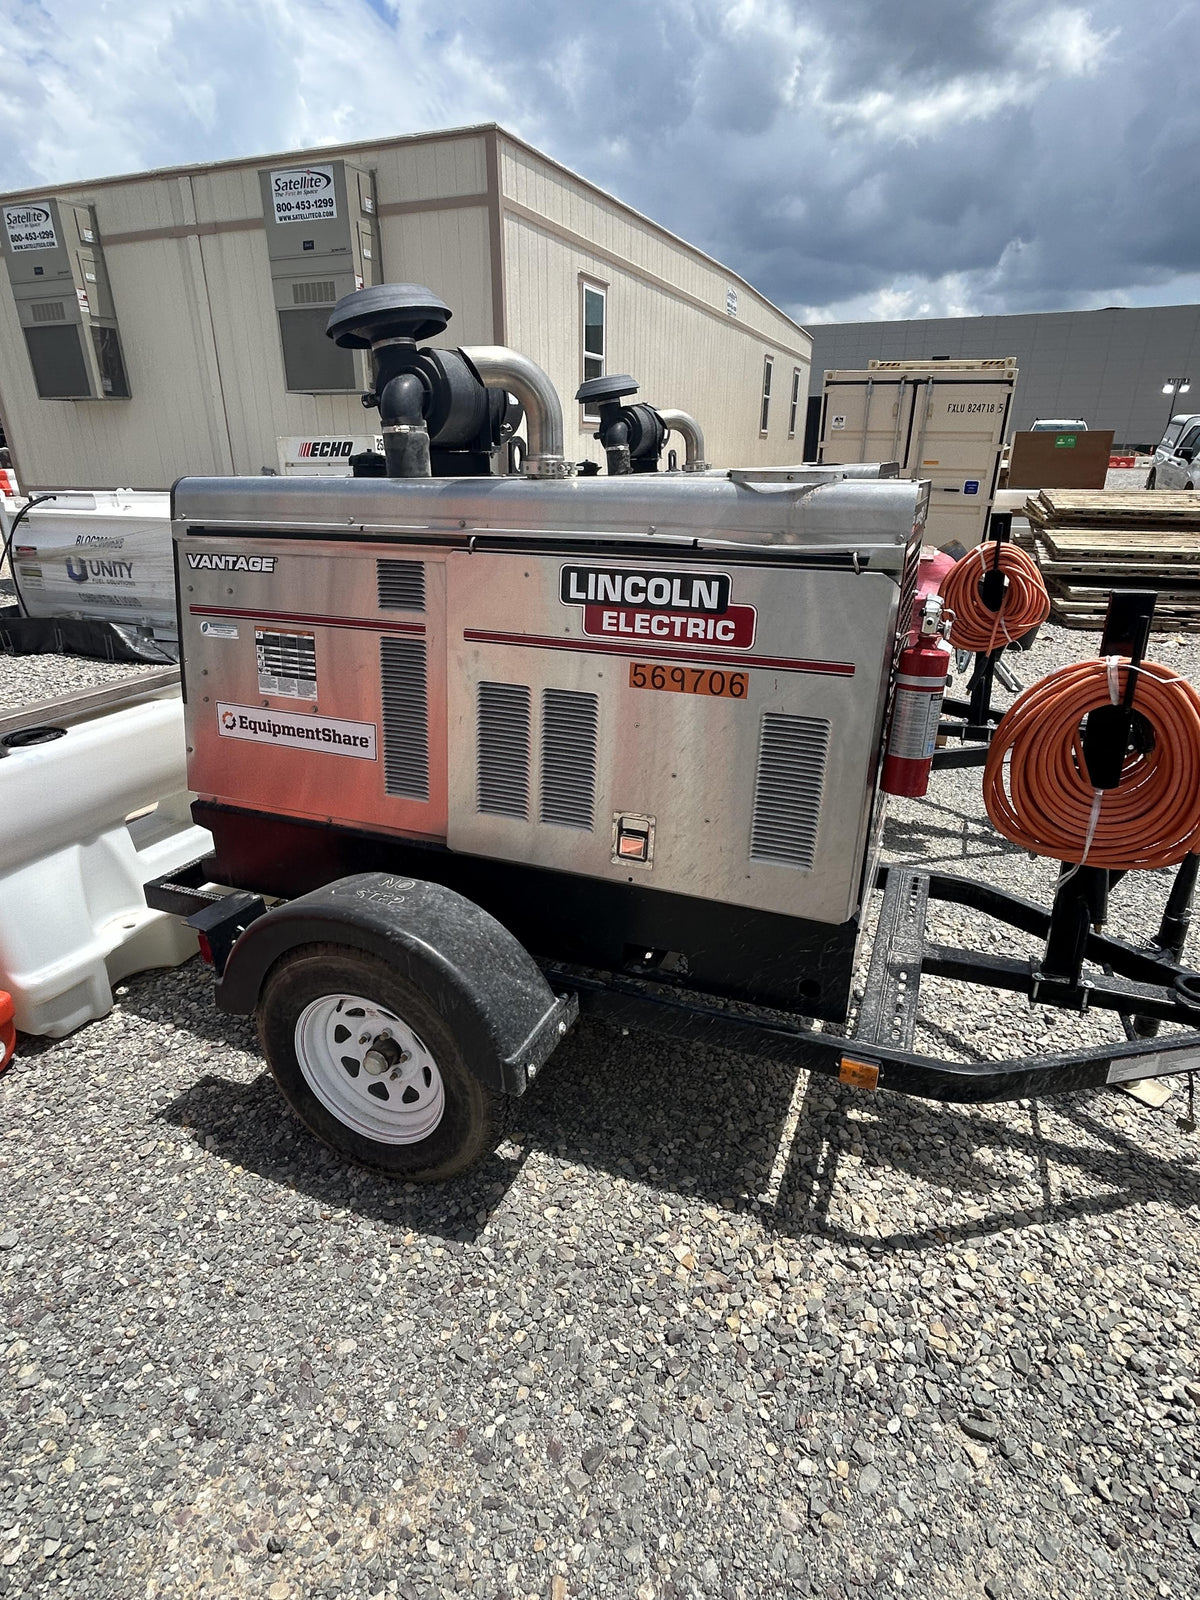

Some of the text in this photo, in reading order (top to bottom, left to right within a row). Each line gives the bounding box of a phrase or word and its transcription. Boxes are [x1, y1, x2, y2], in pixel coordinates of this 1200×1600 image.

[274, 175, 322, 192] Satellite
[276, 198, 334, 213] 800-453-1299
[7, 211, 43, 225] Satellite
[278, 211, 335, 222] WWW.SATELLITECO.COM
[11, 230, 55, 243] 800-453-1299
[947, 403, 1004, 414] FXLU 824718 5
[310, 441, 354, 458] ECHO
[89, 560, 133, 578] UNITY
[187, 553, 275, 573] VANTAGE
[569, 572, 720, 609] LINCOLN
[602, 610, 736, 641] ELECTRIC
[632, 663, 745, 697] 569706
[239, 715, 370, 748] EquipmentShare
[378, 877, 416, 891] NO
[356, 889, 405, 905] STEP
